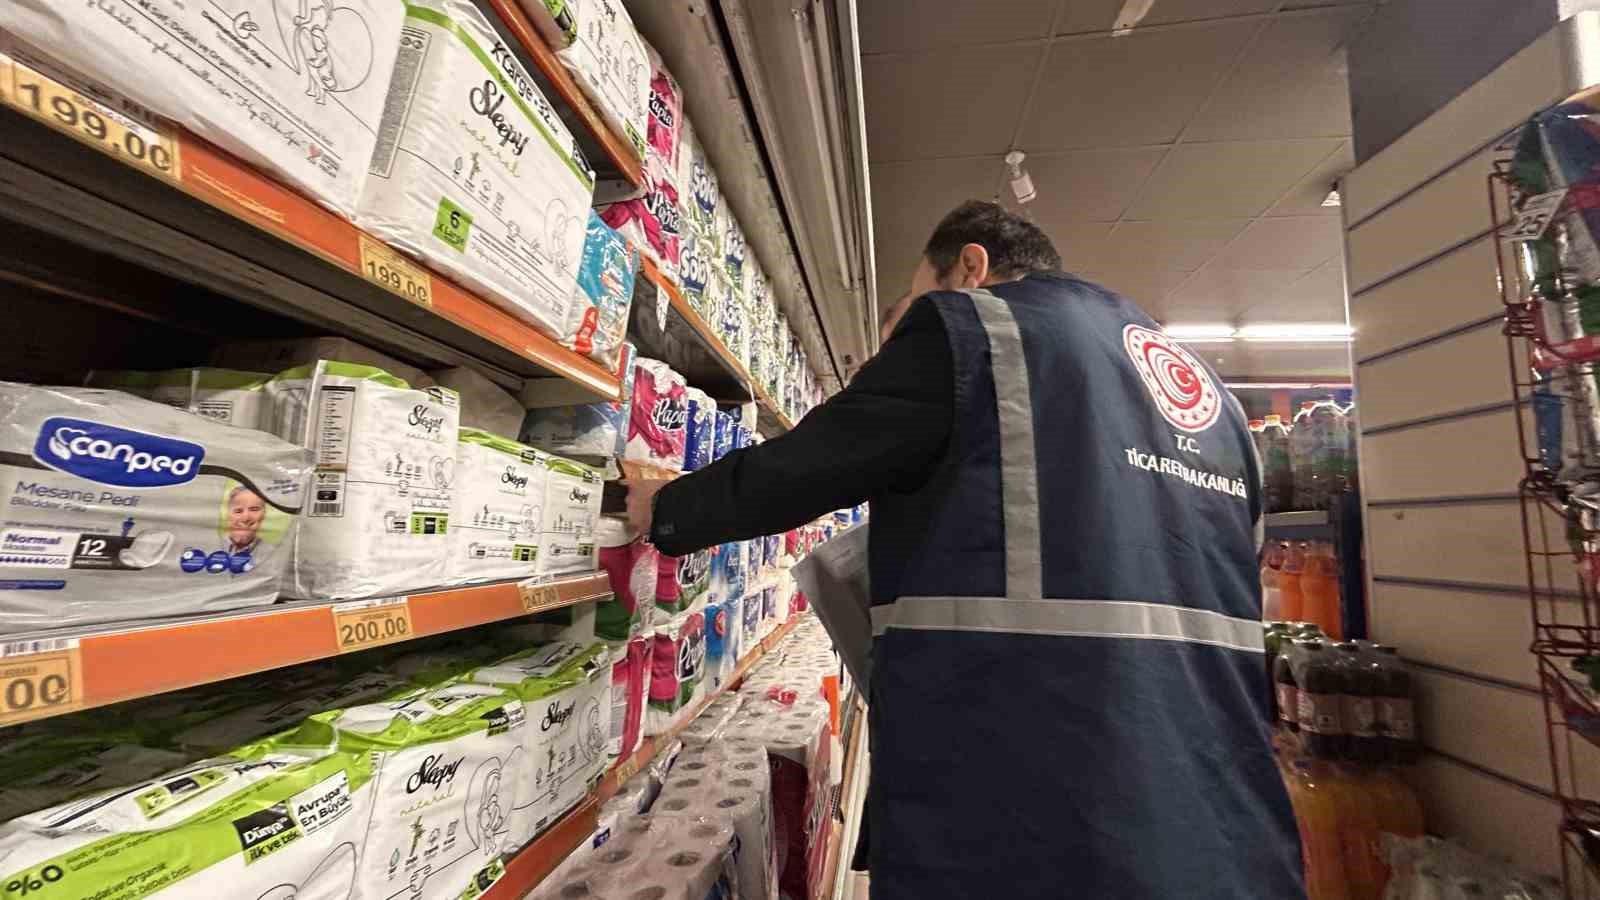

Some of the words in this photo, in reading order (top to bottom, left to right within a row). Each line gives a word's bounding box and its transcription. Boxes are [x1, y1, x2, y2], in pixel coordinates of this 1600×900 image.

[469, 79, 530, 156] Sleepy
[450, 211, 460, 230] 6
[70, 436, 195, 476] canped
[1174, 434, 1200, 454] T.C.
[15, 480, 95, 503] Mesane
[99, 491, 140, 506] Pedi
[5, 533, 62, 545] Normal
[80, 539, 107, 556] 12
[342, 616, 406, 646] 200.00
[406, 752, 465, 794] Sleepy
